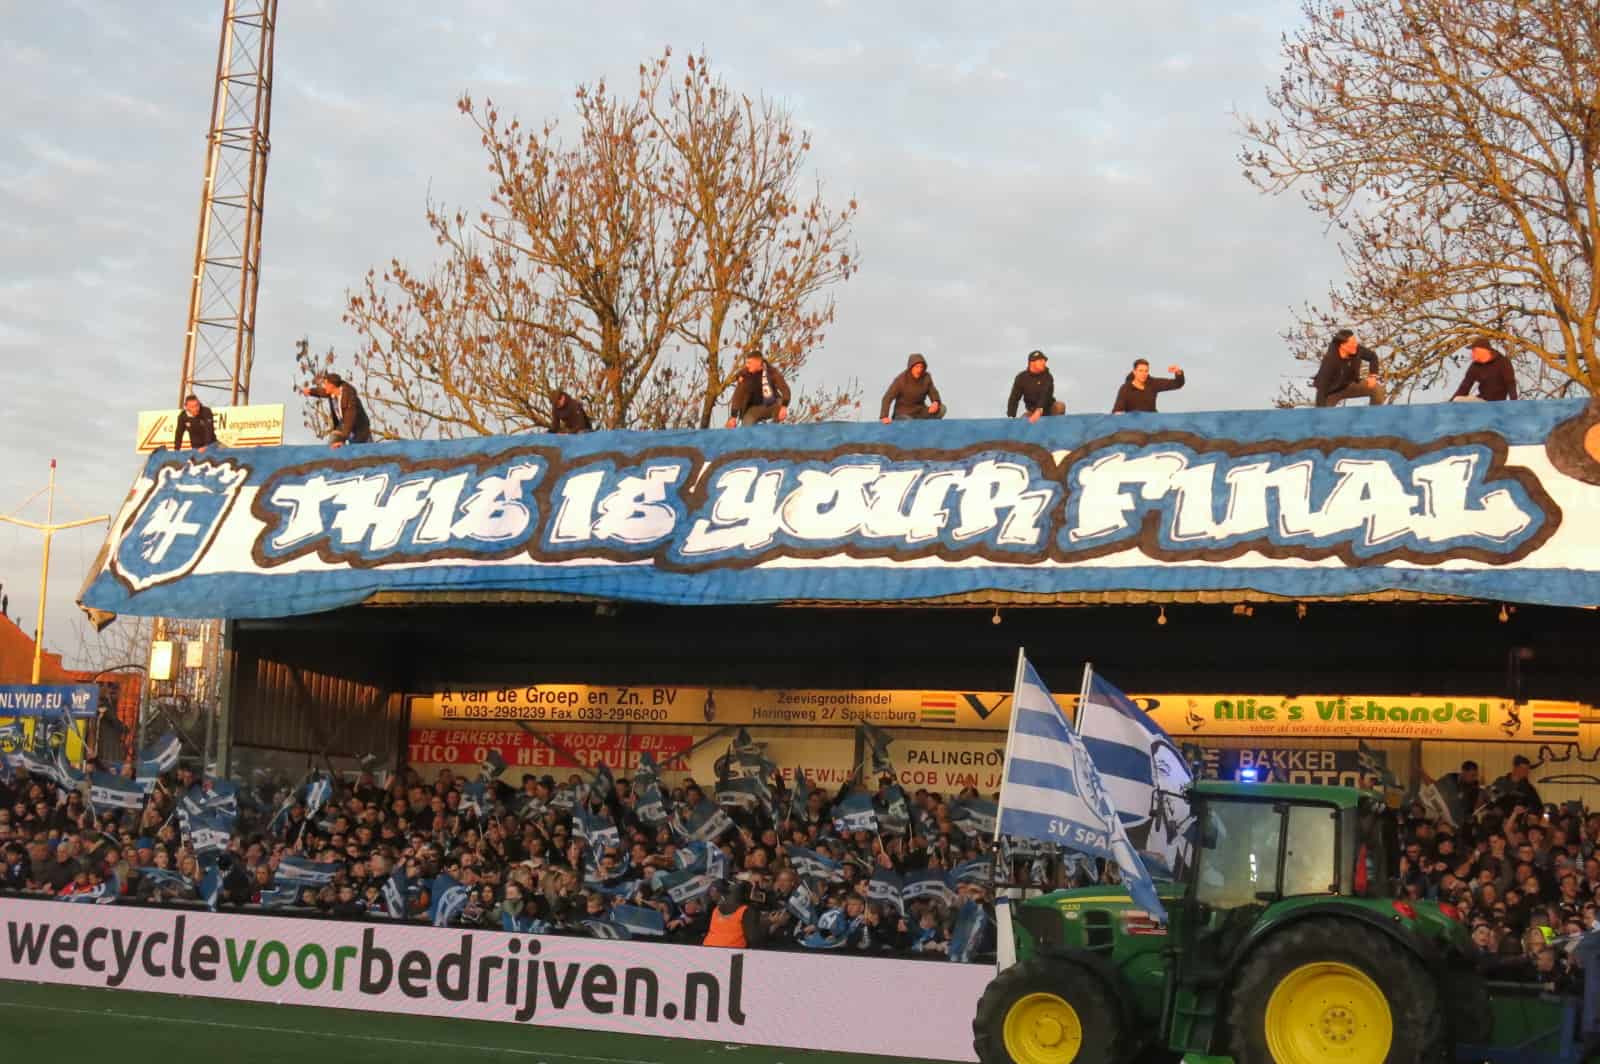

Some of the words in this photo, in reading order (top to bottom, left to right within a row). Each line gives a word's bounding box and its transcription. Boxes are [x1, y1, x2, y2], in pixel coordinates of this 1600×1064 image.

[549, 464, 681, 545] IS
[459, 690, 489, 702] van
[496, 687, 517, 703] de
[525, 687, 579, 707] Groep
[587, 690, 609, 704] en
[616, 688, 644, 705] Zn.
[653, 688, 678, 705] BV
[777, 692, 892, 706] Zeevisgroothandel
[465, 706, 546, 719] 033-2981239
[551, 706, 573, 719] Fax
[752, 707, 816, 721] Haringweg
[841, 707, 917, 722] Spakenburg
[1213, 698, 1305, 721] Alie's
[1315, 698, 1489, 723] Vishandel
[420, 730, 437, 744] DE
[445, 729, 521, 745] LEKKERSTE
[564, 734, 608, 748] KOOP
[409, 745, 459, 763] TICO
[516, 748, 556, 767] HET
[573, 749, 690, 771] SPUIPEIN
[1239, 750, 1336, 769] BAKKER
[945, 772, 979, 788] VAN
[1048, 819, 1071, 836] SV
[7, 914, 746, 1027] wecyclevoorbedrijven.nl
